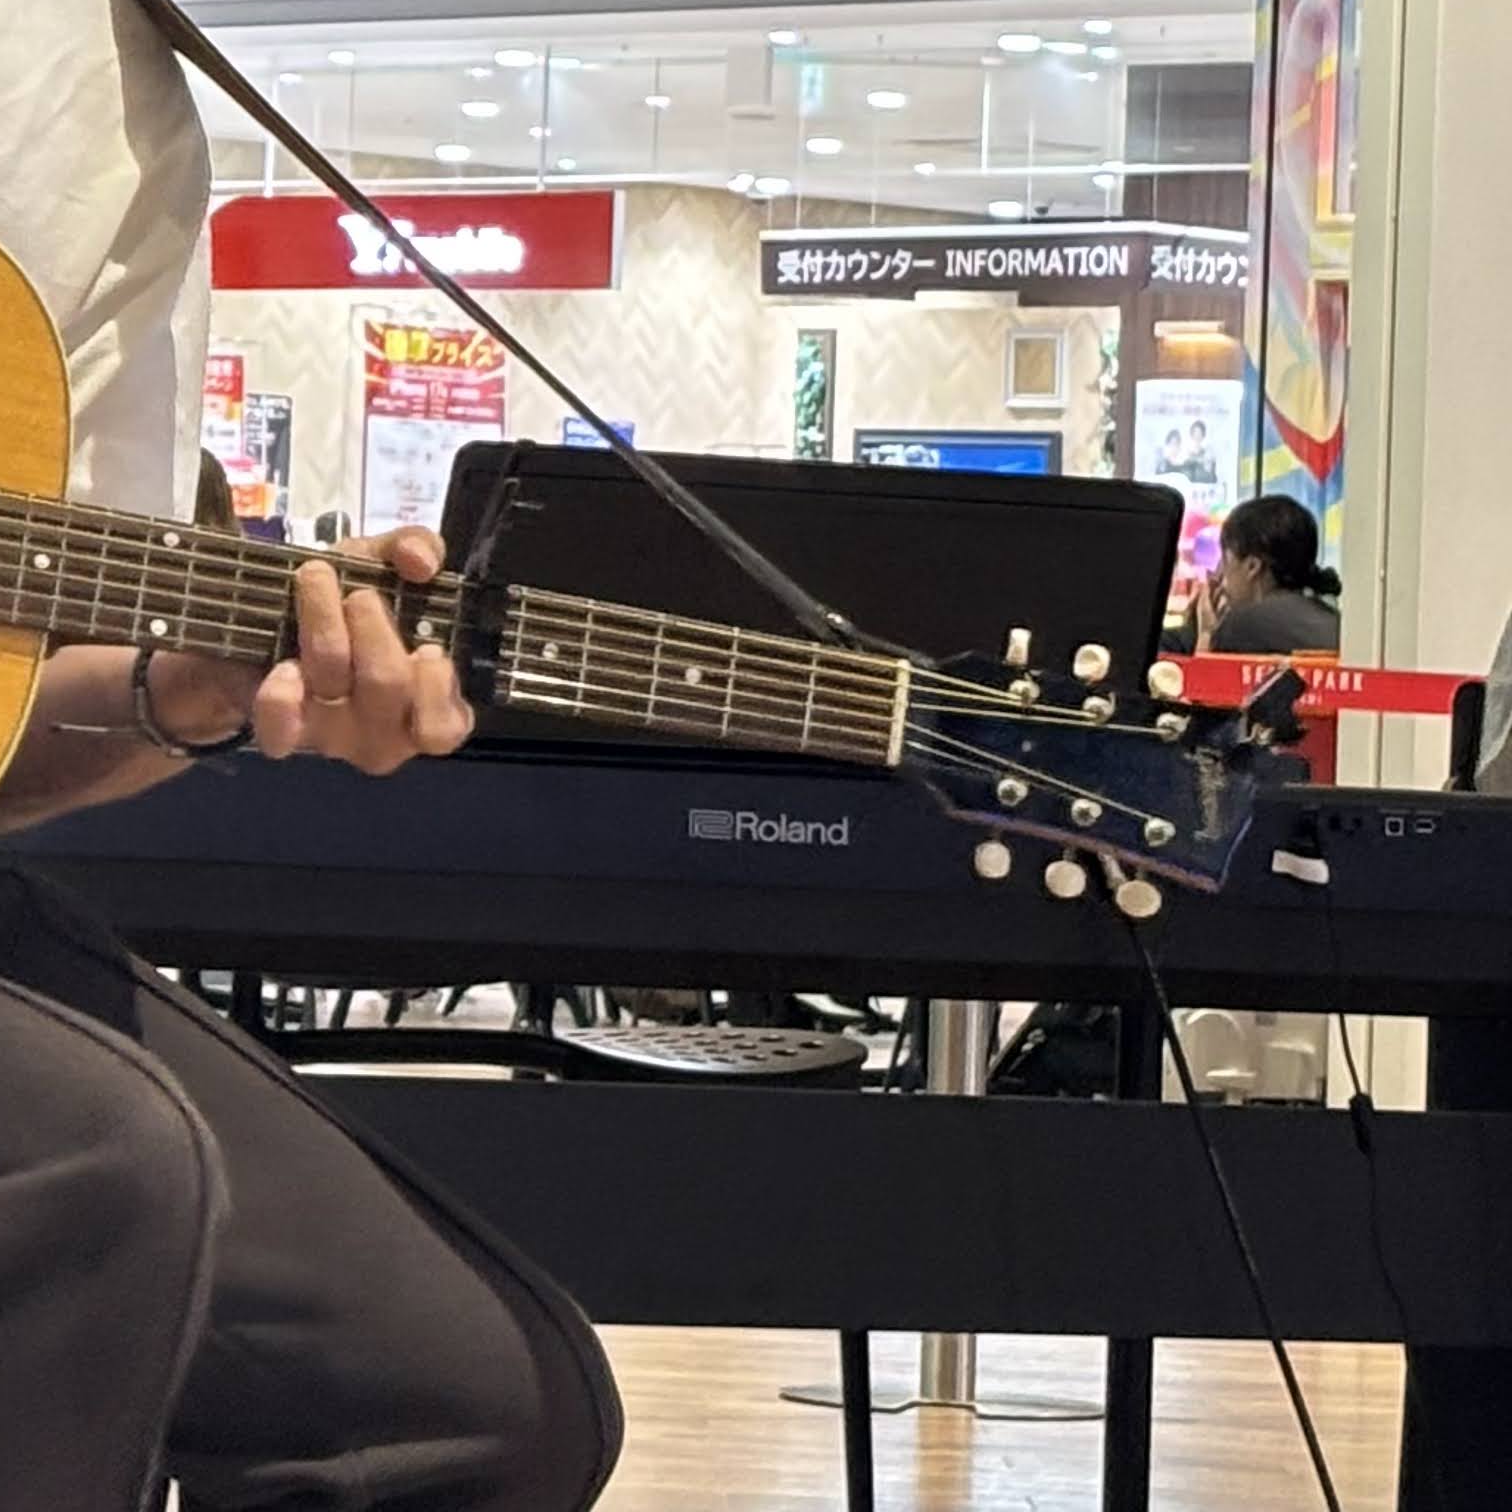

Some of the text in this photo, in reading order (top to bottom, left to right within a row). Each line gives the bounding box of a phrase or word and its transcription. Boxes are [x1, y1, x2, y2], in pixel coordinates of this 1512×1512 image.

[776, 244, 1130, 285] 受付カウンター INFORMATION
[1312, 668, 1363, 692] PARK
[735, 810, 849, 846] Roland
